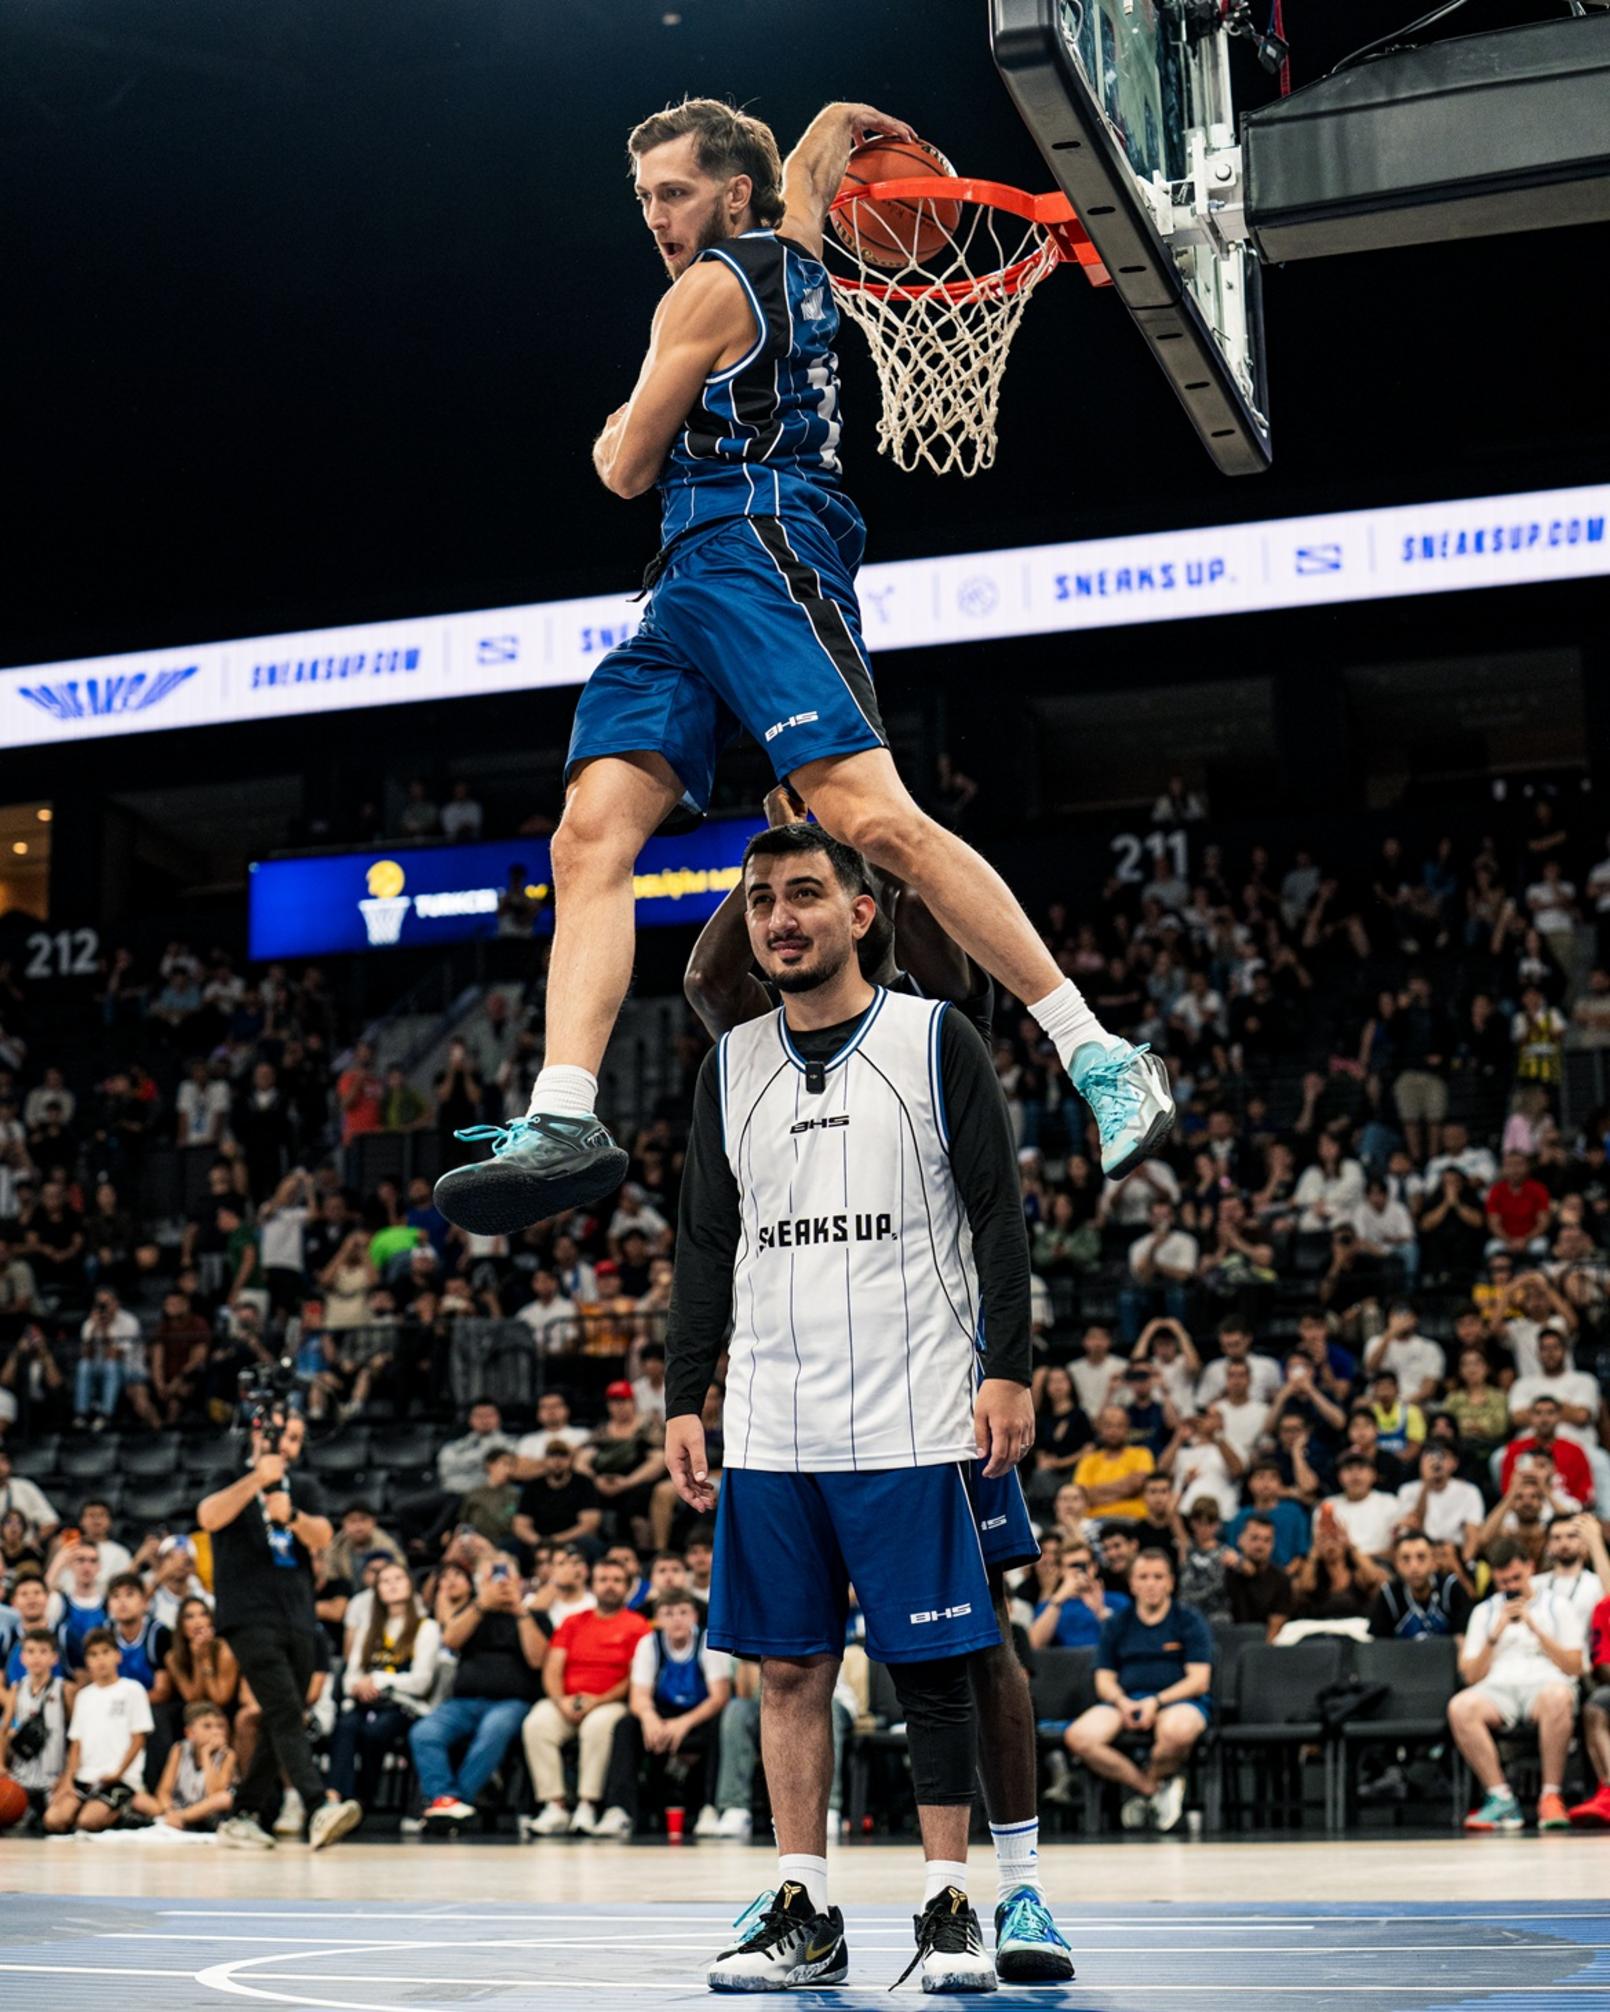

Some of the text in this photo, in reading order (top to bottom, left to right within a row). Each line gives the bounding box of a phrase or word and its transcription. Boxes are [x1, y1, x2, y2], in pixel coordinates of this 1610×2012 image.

[1054, 563, 1176, 601] SNEAKS
[1110, 830, 1187, 881] 211
[25, 927, 98, 977] 212
[790, 1115, 850, 1134] BHS
[910, 1603, 972, 1624] BHS
